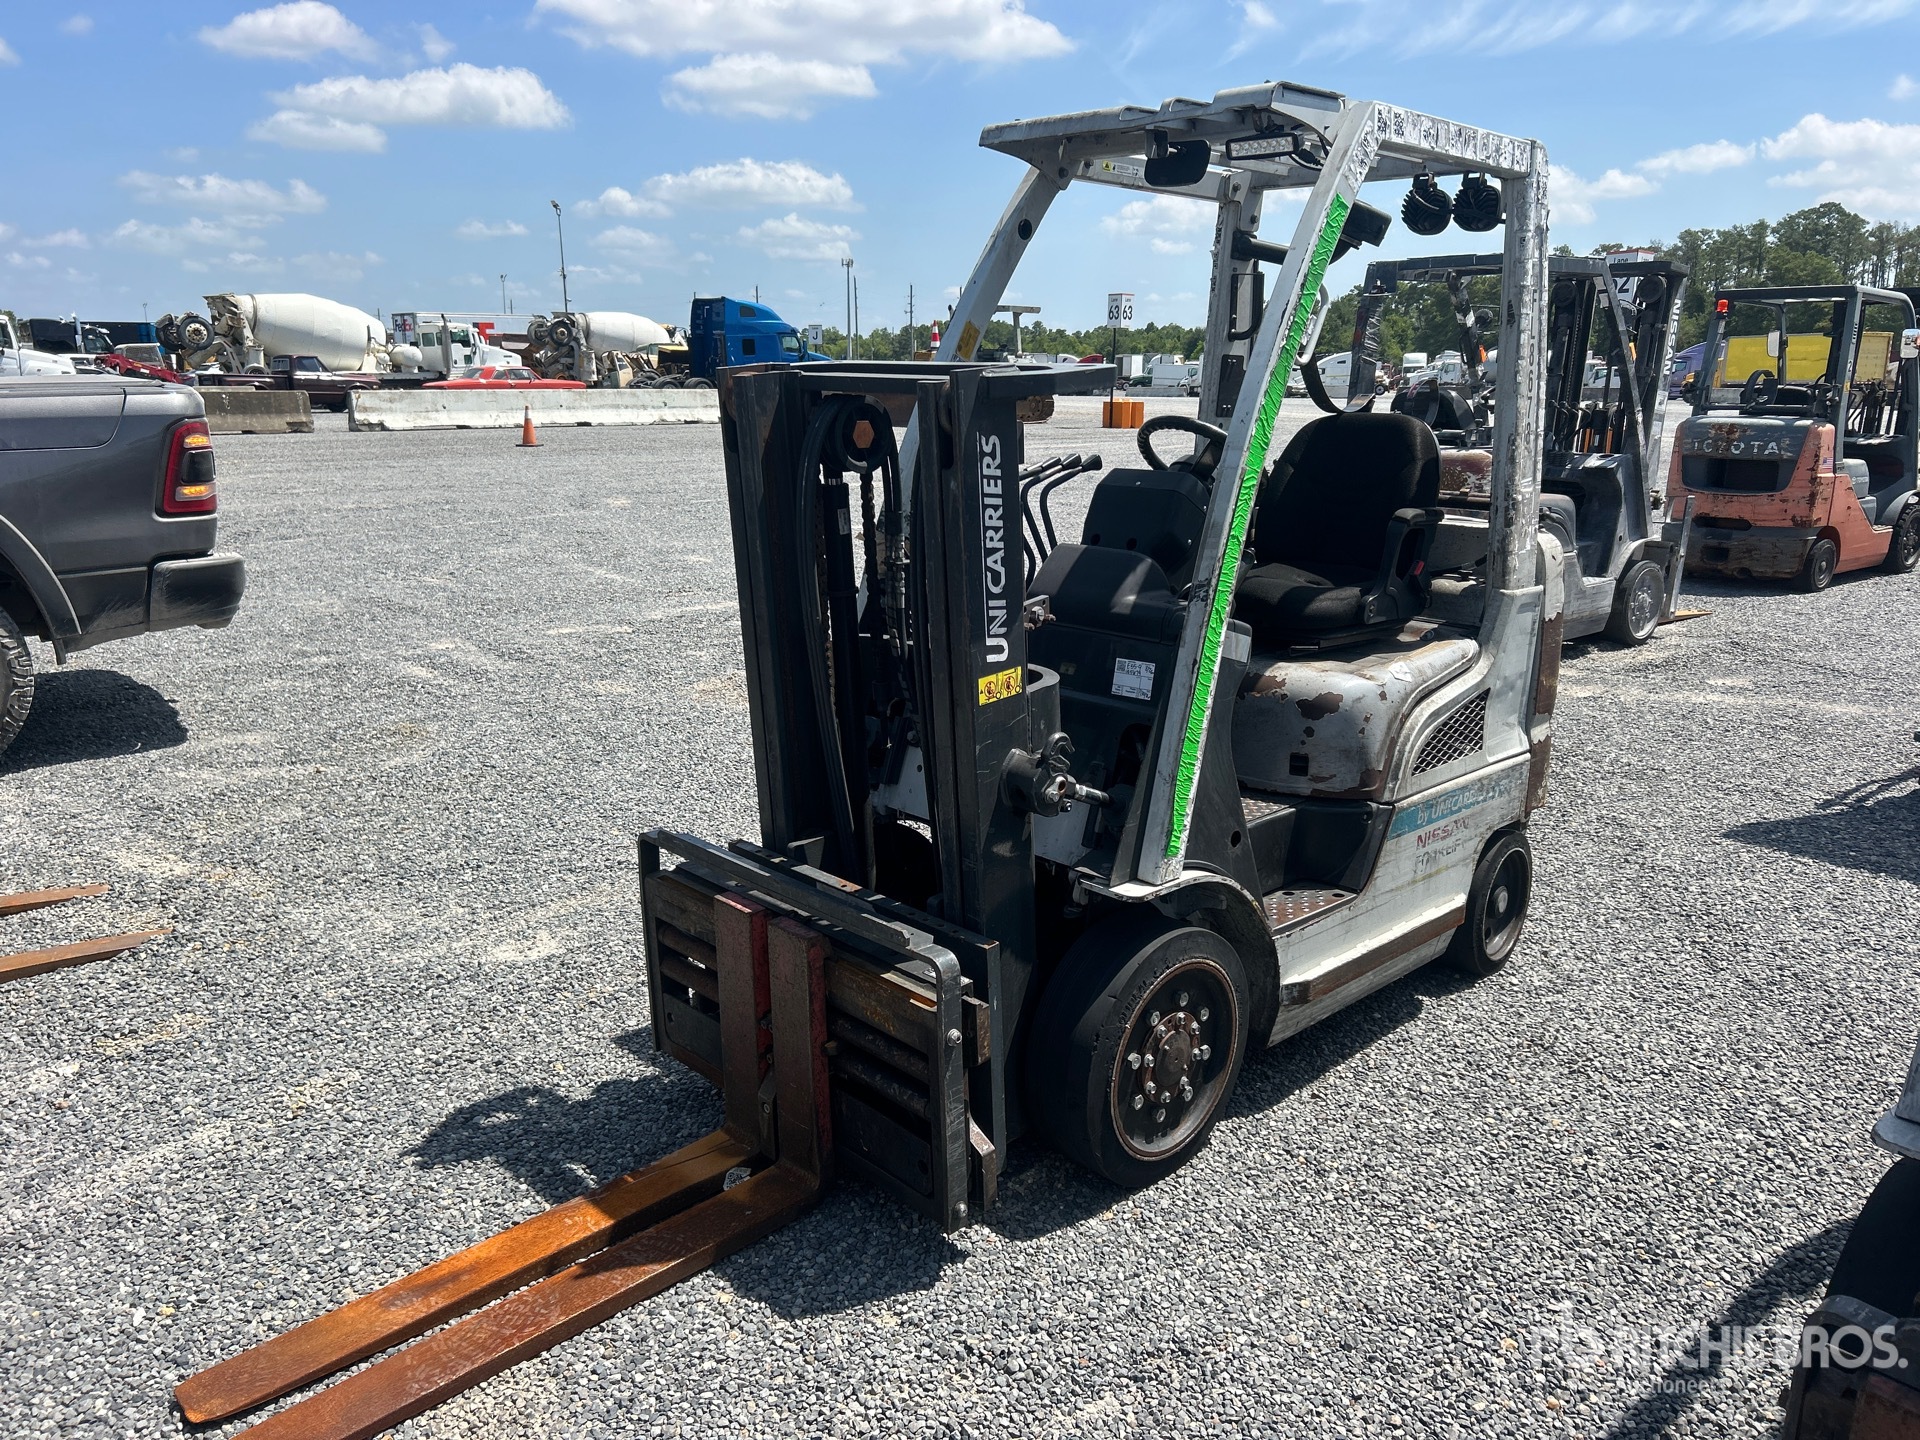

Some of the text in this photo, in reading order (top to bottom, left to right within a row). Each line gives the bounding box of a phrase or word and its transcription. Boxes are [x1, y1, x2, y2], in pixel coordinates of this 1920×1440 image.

[1108, 305, 1119, 320] 63
[1123, 305, 1132, 320] 63
[812, 331, 818, 340] J
[1663, 298, 1682, 376] NISSAN
[980, 434, 1009, 663] UNICARRIERS
